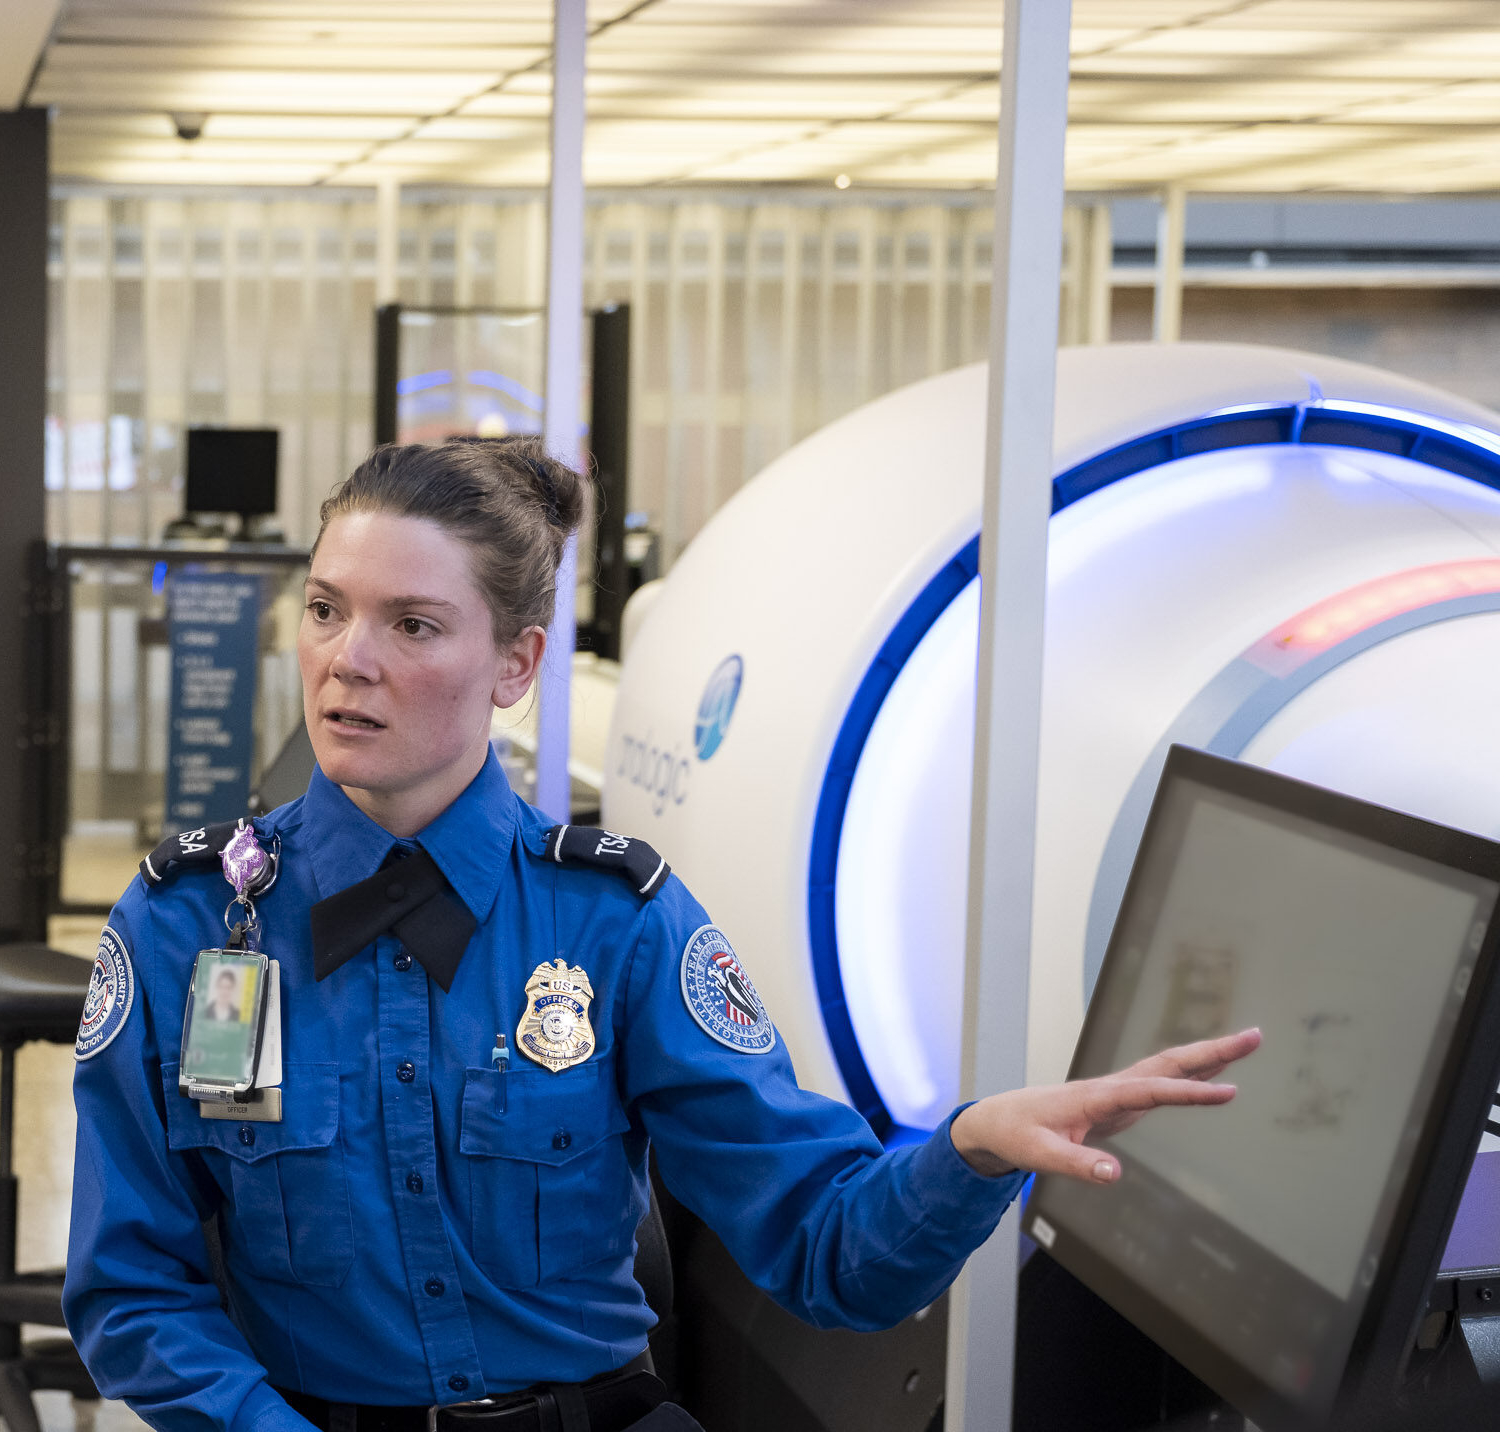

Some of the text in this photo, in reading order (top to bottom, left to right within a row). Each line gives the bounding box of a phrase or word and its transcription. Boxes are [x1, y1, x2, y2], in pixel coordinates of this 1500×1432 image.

[595, 831, 630, 855] TSA
[687, 943, 703, 979] TEAM
[114, 953, 126, 1009] SECURITY
[553, 981, 571, 991] US
[540, 995, 580, 1010] OFFICER
[691, 997, 764, 1047] INTEGRITY
[227, 1106, 248, 1114] OFFICER
